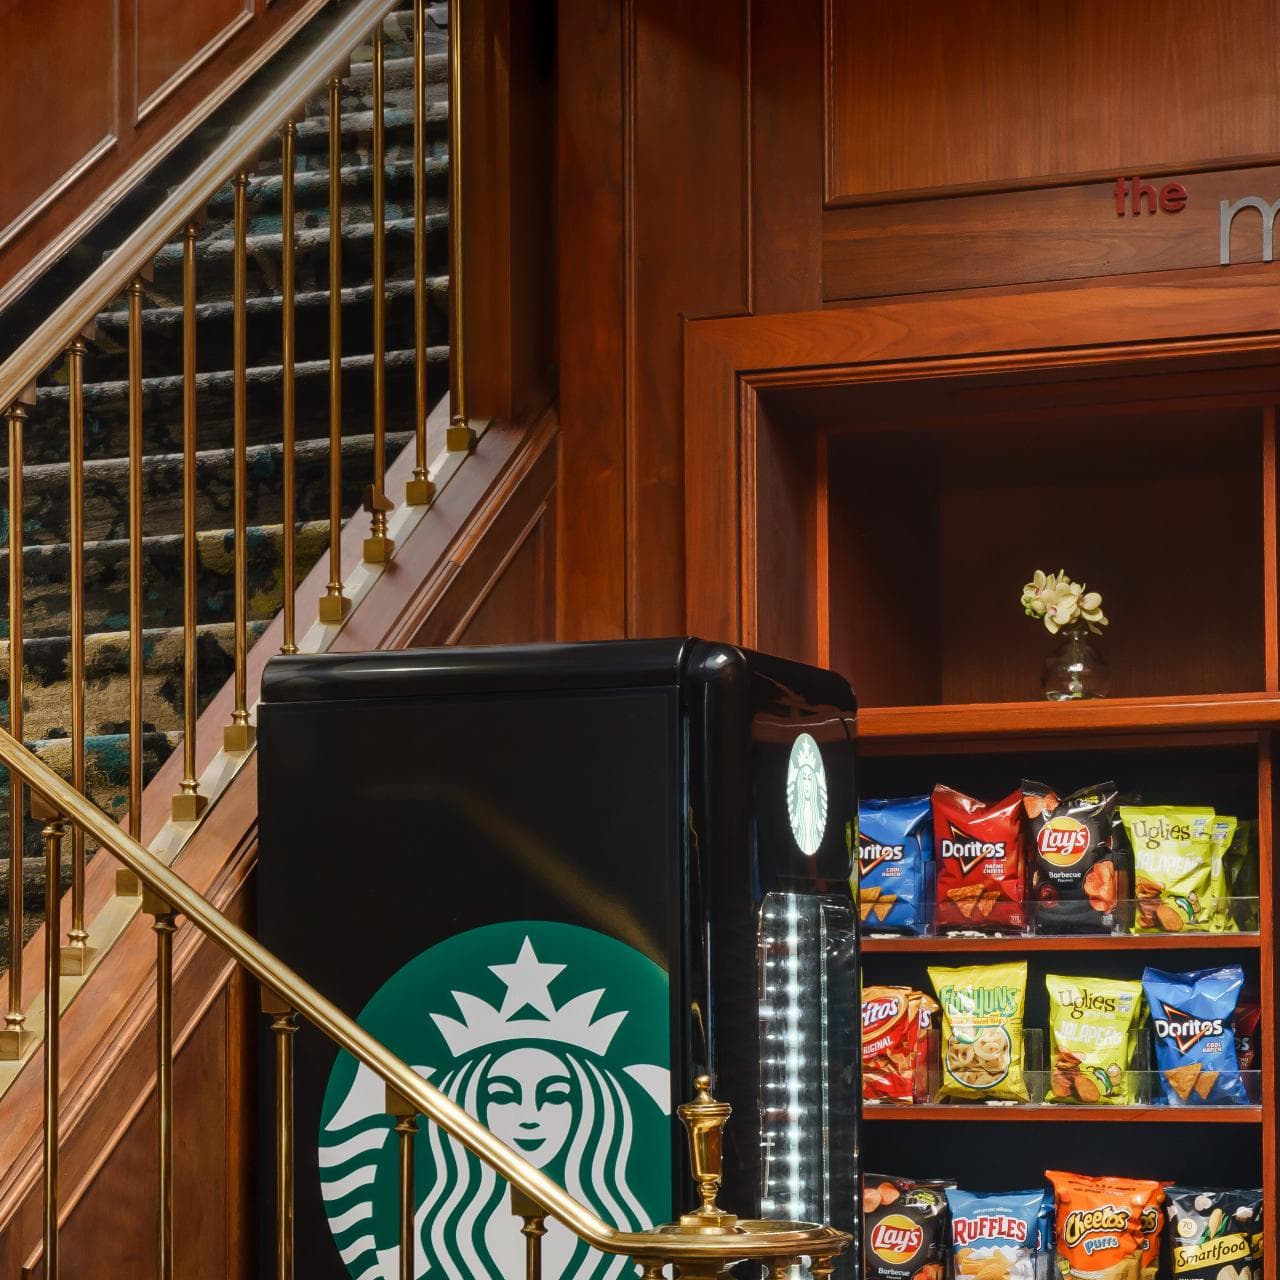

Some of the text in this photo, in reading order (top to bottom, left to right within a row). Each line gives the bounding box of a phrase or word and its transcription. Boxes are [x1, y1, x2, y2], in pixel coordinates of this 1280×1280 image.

[1113, 176, 1188, 217] the
[1040, 829, 1086, 856] Lay's
[1132, 818, 1191, 850] Uglies
[858, 845, 904, 861] oritos
[942, 839, 1005, 858] Doritos
[862, 998, 899, 1028] ritos
[1058, 989, 1116, 1020] Uglies
[1155, 1020, 1223, 1038] Doritos
[863, 1036, 894, 1056] RIGINAL
[875, 1225, 921, 1253] Lay's
[953, 1216, 1027, 1245] RUFFLES
[1065, 1206, 1131, 1246] Cheetos
[1176, 1239, 1247, 1268] Smartfood
[878, 1267, 911, 1276] Barbecue
